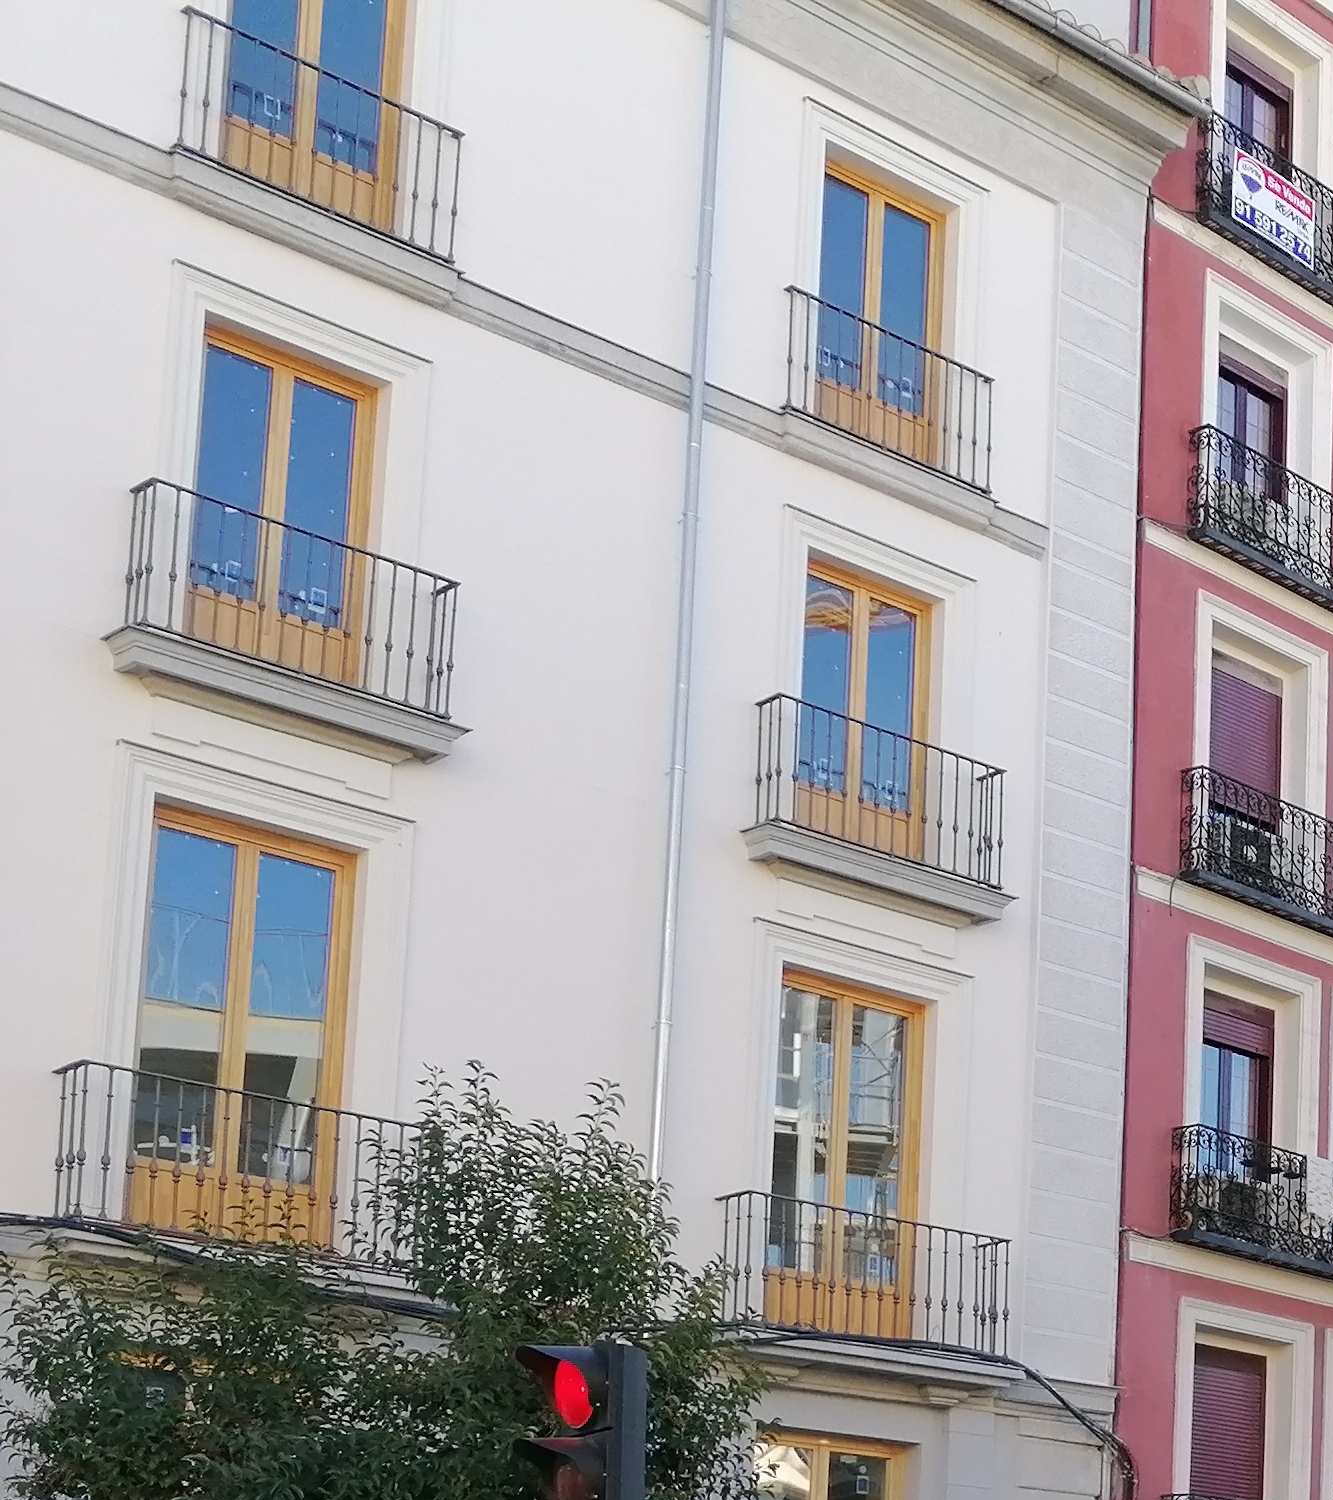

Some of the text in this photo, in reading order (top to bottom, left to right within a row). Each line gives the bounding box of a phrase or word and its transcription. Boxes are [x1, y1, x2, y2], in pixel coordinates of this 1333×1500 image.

[1267, 175, 1311, 214] Se Vende
[1235, 198, 1311, 261] 91 591 25 74
